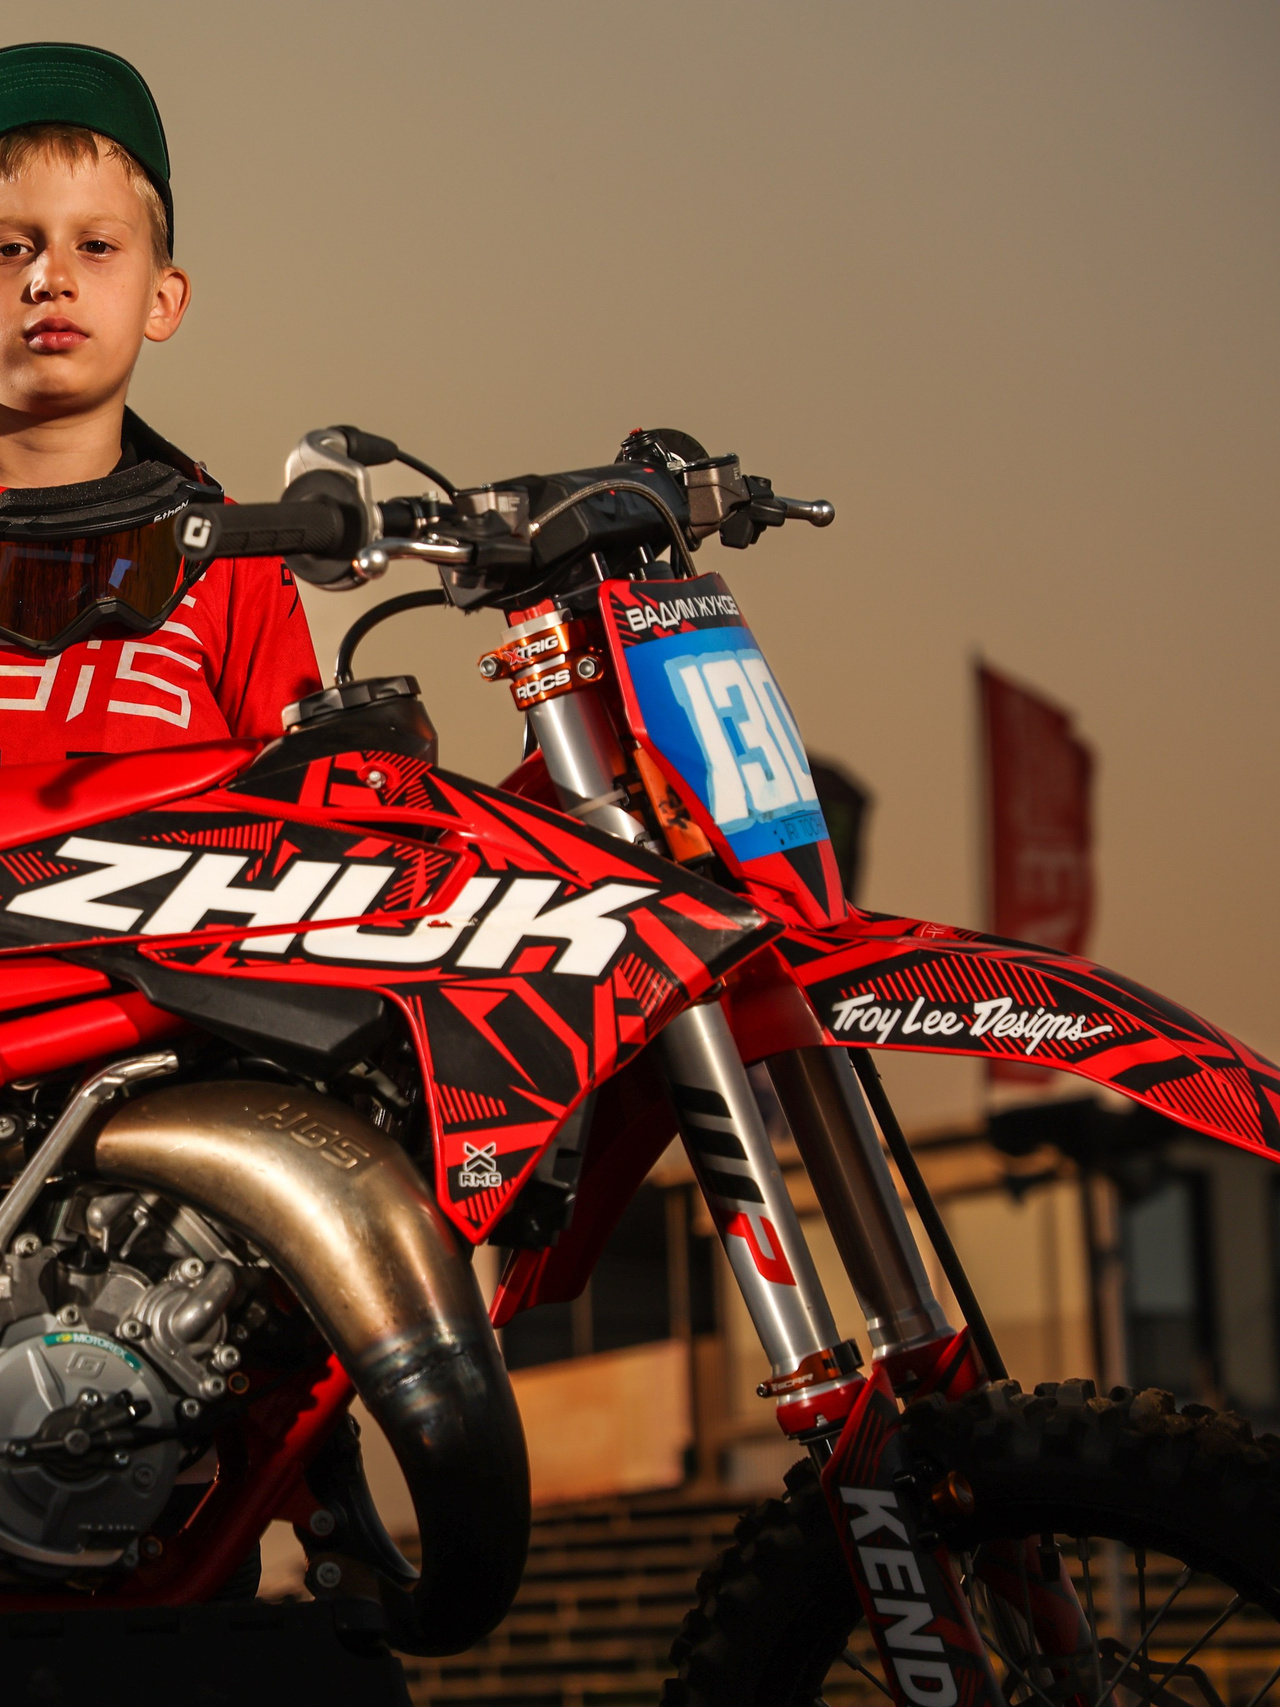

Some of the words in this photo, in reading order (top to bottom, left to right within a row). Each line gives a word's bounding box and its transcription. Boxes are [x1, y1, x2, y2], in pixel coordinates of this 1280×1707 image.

[625, 597, 699, 632] ВАДИМ
[503, 635, 559, 665] XTRIG
[516, 669, 571, 699] ROCS
[678, 659, 818, 825] 130
[5, 836, 660, 976] ZHUK
[831, 993, 902, 1044] Troy
[901, 996, 965, 1036] Lee
[969, 997, 1113, 1057] Designs
[459, 1171, 502, 1187] RMG
[73, 1333, 128, 1359] MOTOREX
[839, 1486, 959, 1707] KEND
